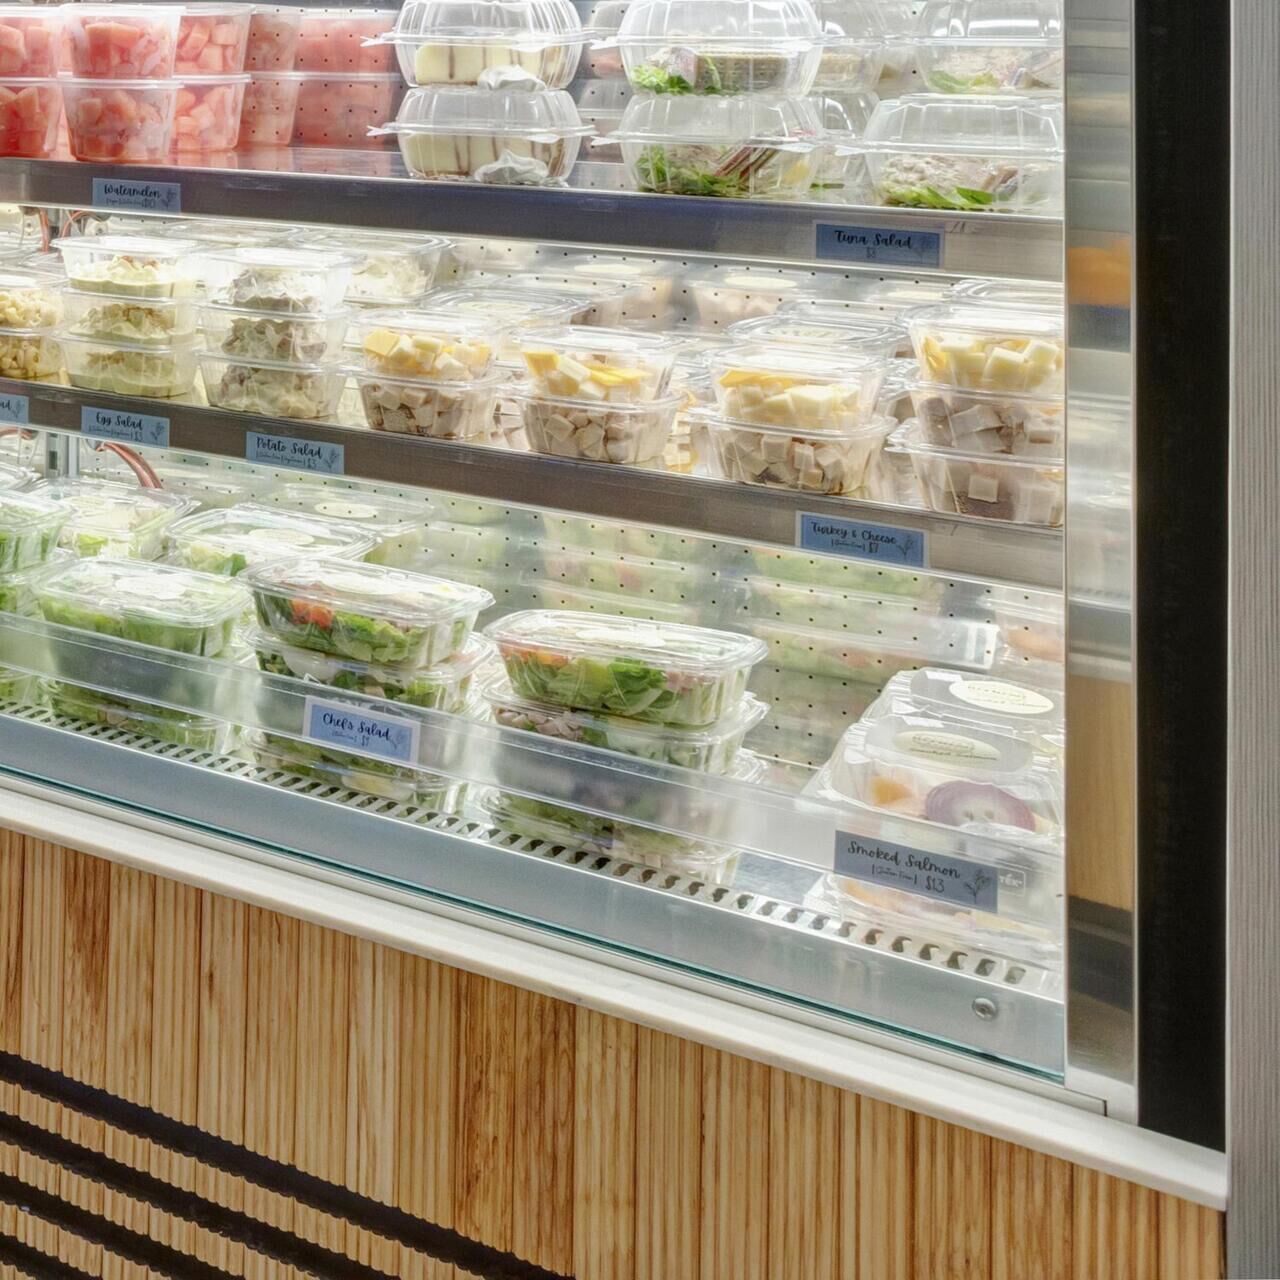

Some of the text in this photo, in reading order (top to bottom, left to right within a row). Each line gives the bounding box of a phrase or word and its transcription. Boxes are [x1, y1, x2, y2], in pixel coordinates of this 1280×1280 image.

[104, 183, 161, 200] Watermelon
[834, 229, 913, 249] Tuna Salad
[96, 411, 144, 431] Egg Salad
[256, 436, 322, 458] Potato Salad
[810, 521, 849, 539] Turkey
[861, 530, 897, 545] Cheese
[357, 720, 391, 741] Salad
[847, 840, 961, 879] Smoked Salmon
[924, 875, 945, 893] $13
